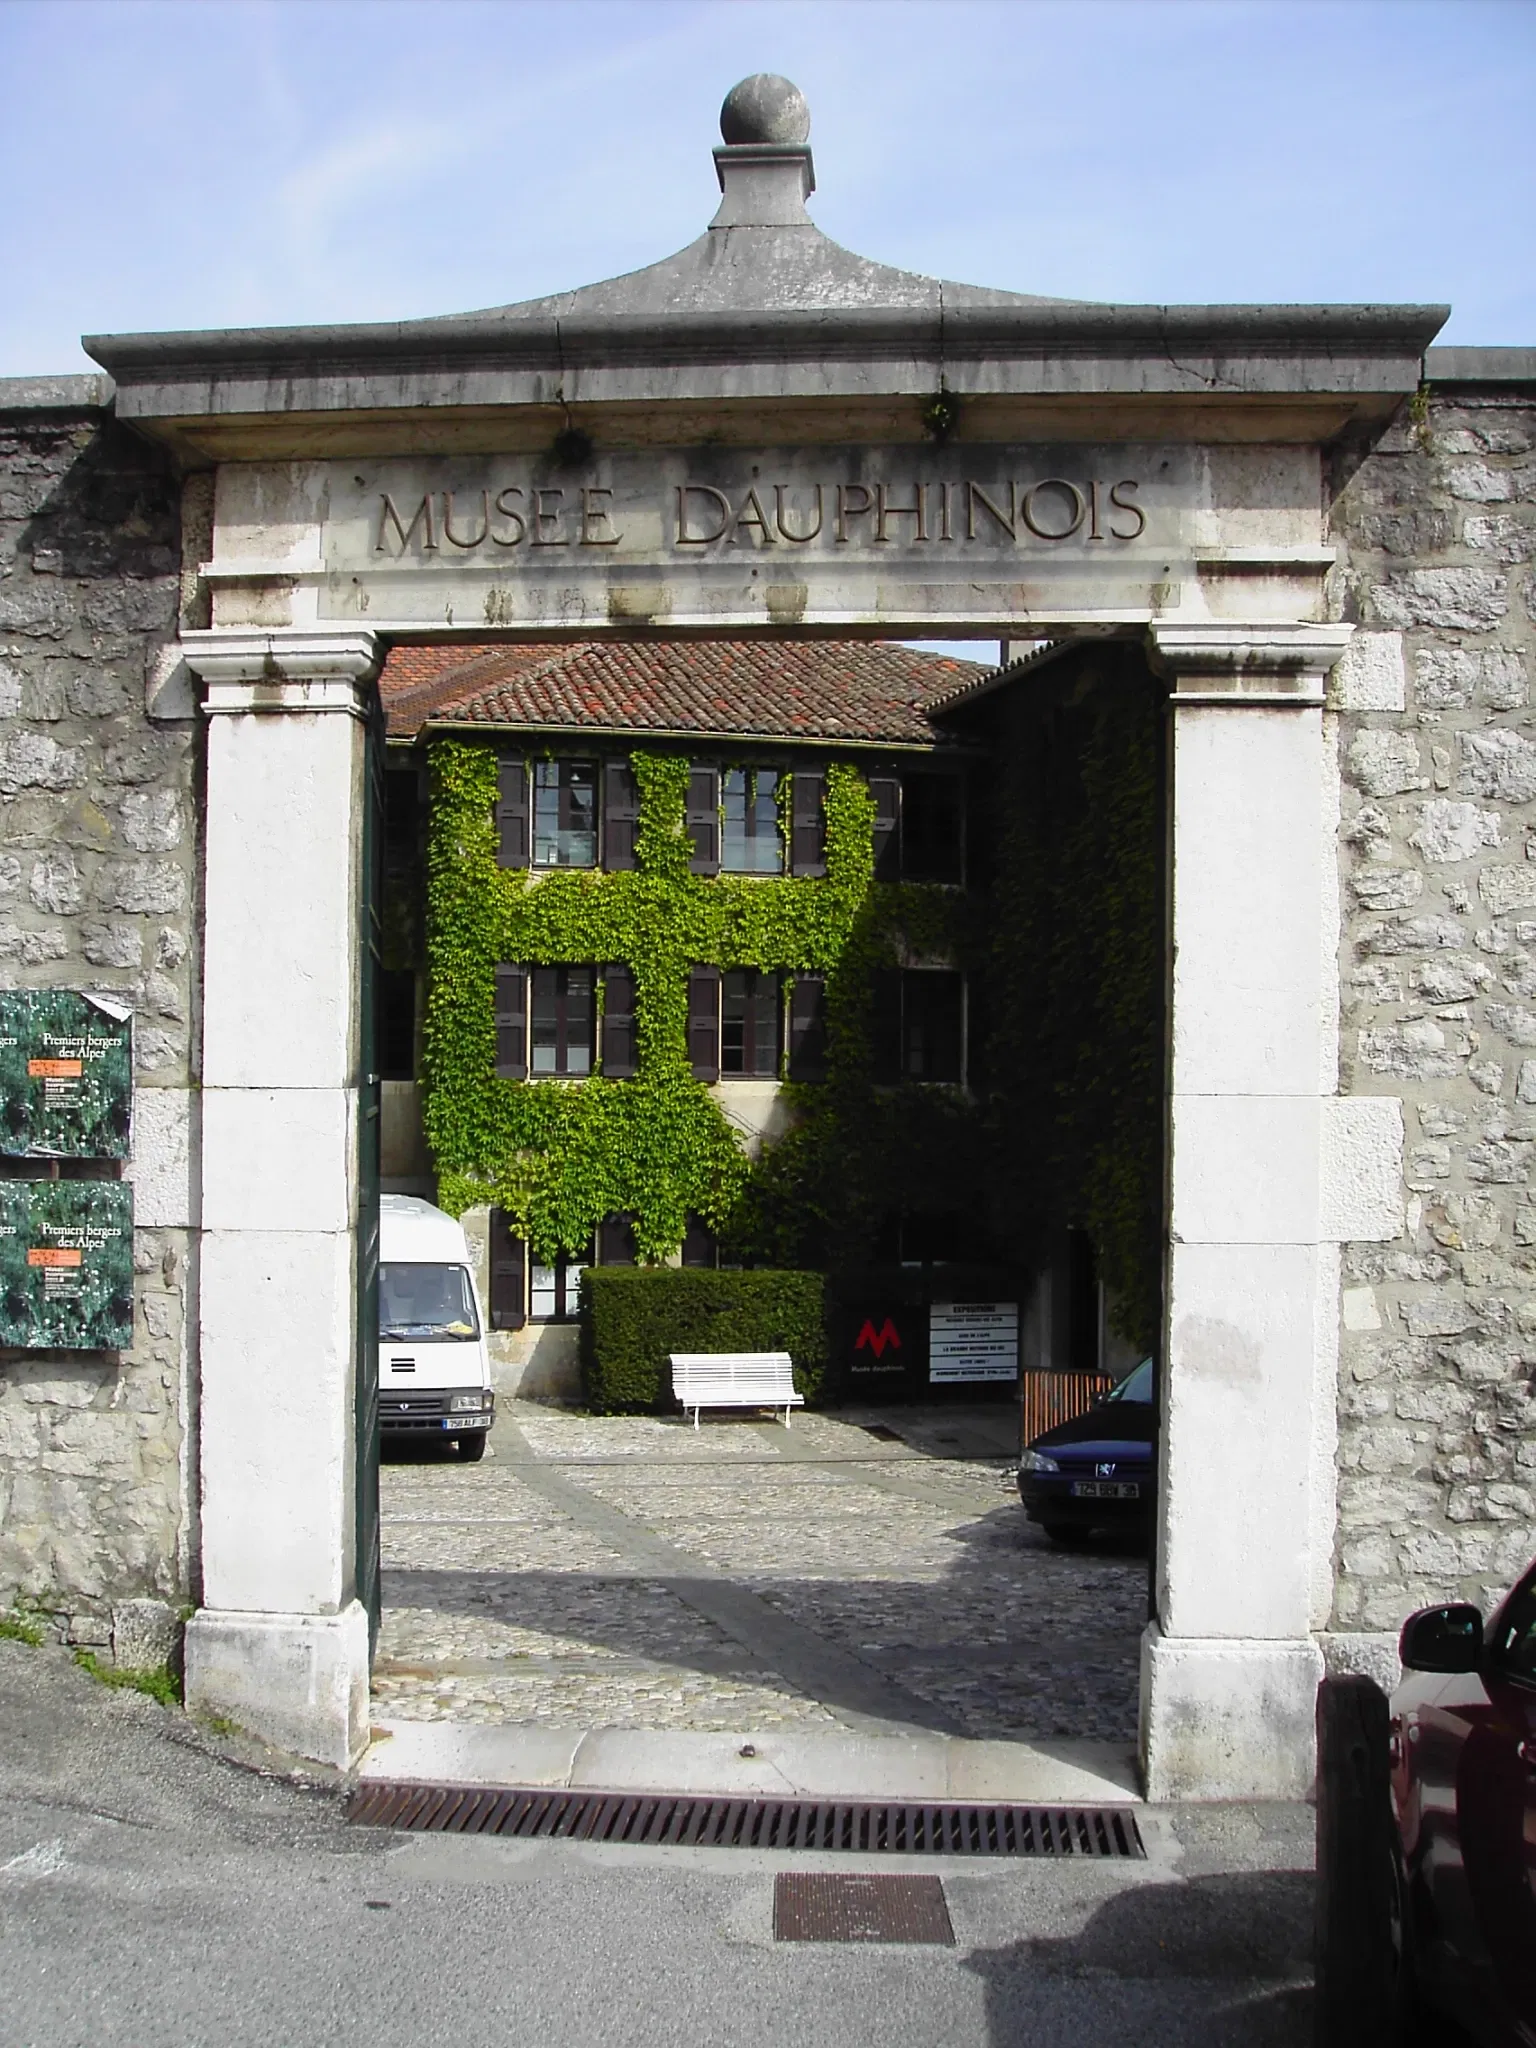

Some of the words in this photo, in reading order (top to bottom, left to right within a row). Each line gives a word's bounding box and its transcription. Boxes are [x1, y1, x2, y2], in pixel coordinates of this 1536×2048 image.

[375, 487, 623, 552] MUSEE
[675, 478, 1146, 545] DAUPHINOIS
[43, 1032, 86, 1046] Premiers
[87, 1034, 123, 1049] bergers
[59, 1046, 77, 1059] des
[78, 1047, 106, 1062] Alpes
[42, 1222, 85, 1236] Premiers
[86, 1224, 122, 1238] bergers
[57, 1236, 75, 1248] des
[76, 1237, 106, 1252] Alpes
